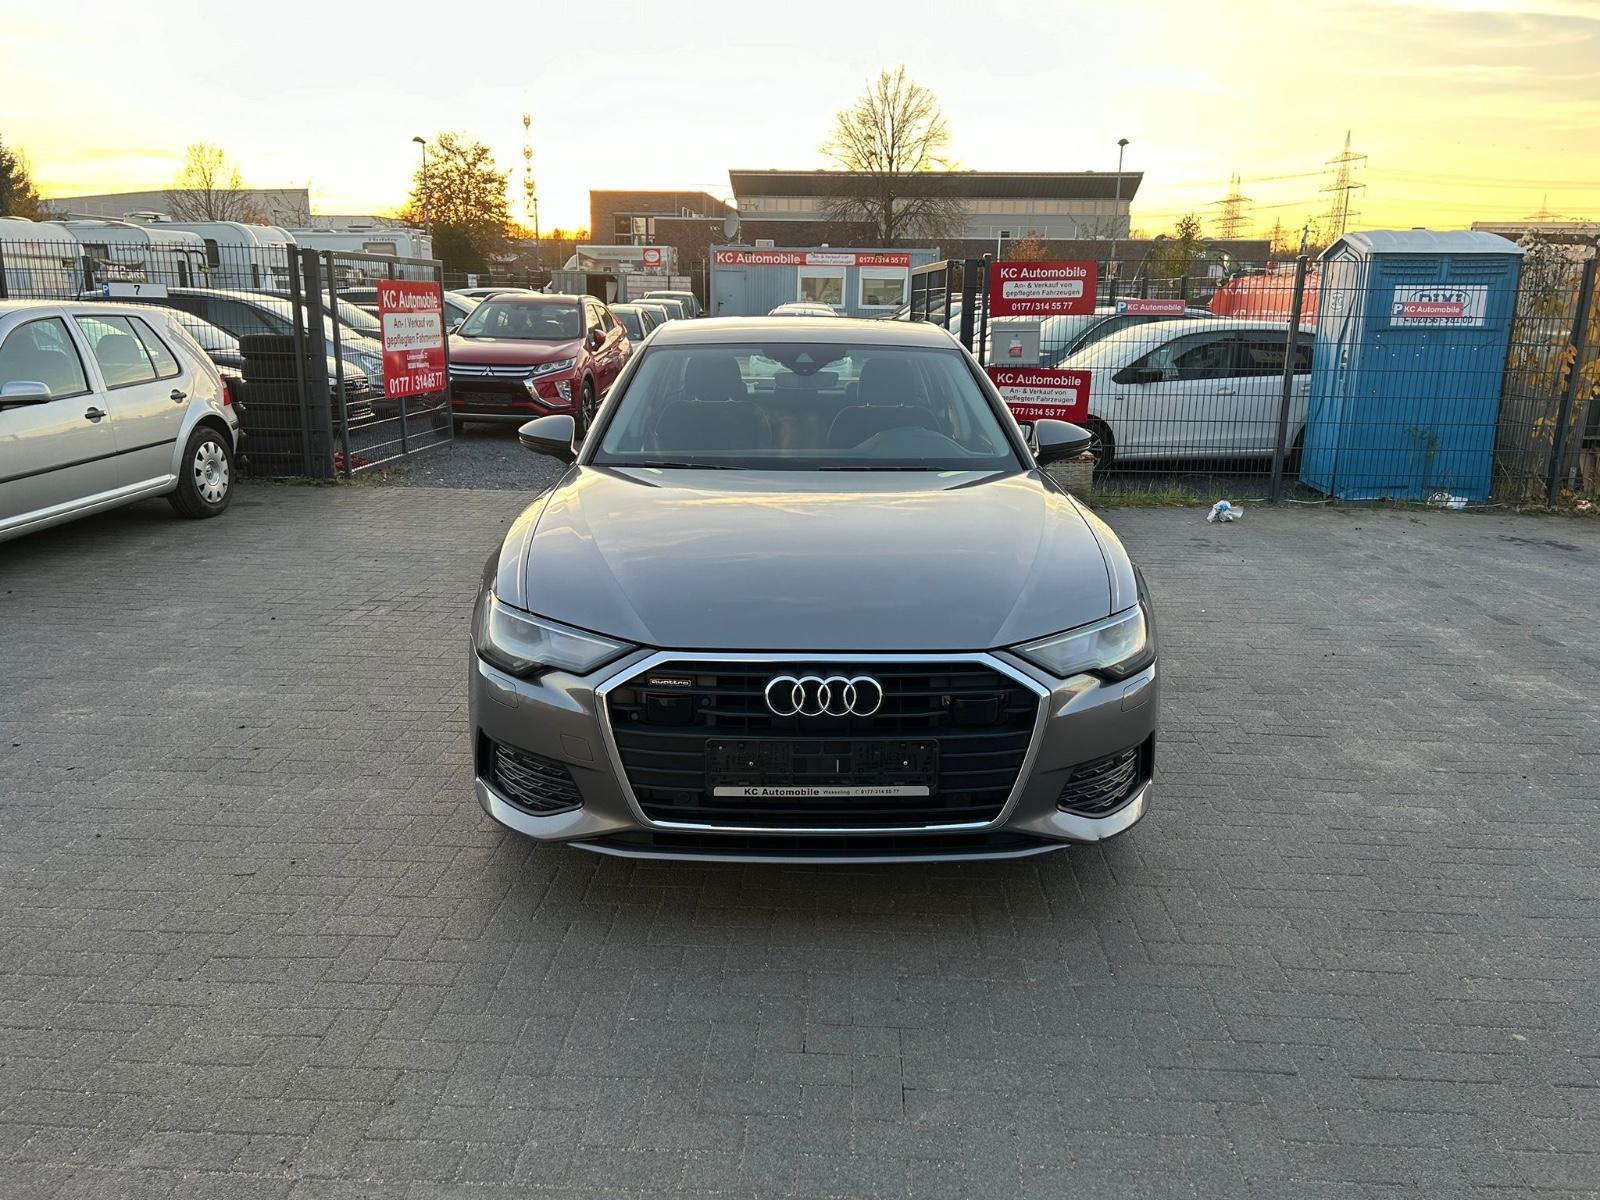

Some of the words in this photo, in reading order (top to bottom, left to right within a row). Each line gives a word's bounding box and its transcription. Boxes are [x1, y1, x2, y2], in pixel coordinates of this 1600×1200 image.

[716, 252, 733, 264] KC
[736, 252, 800, 264] Automobile
[1000, 268, 1018, 278] KC
[1020, 266, 1087, 278] Automobile
[134, 284, 141, 296] 7
[1042, 289, 1080, 297] Fahrzeugen
[382, 289, 397, 308] KC
[399, 290, 438, 309] Automobile
[1117, 302, 1126, 312] P
[1393, 304, 1403, 314] P
[407, 317, 426, 328] Verkauf
[426, 318, 434, 327] von
[390, 376, 409, 394] 0177
[436, 372, 443, 386] 77
[996, 373, 1014, 384] KC
[1016, 374, 1082, 386] Automobile
